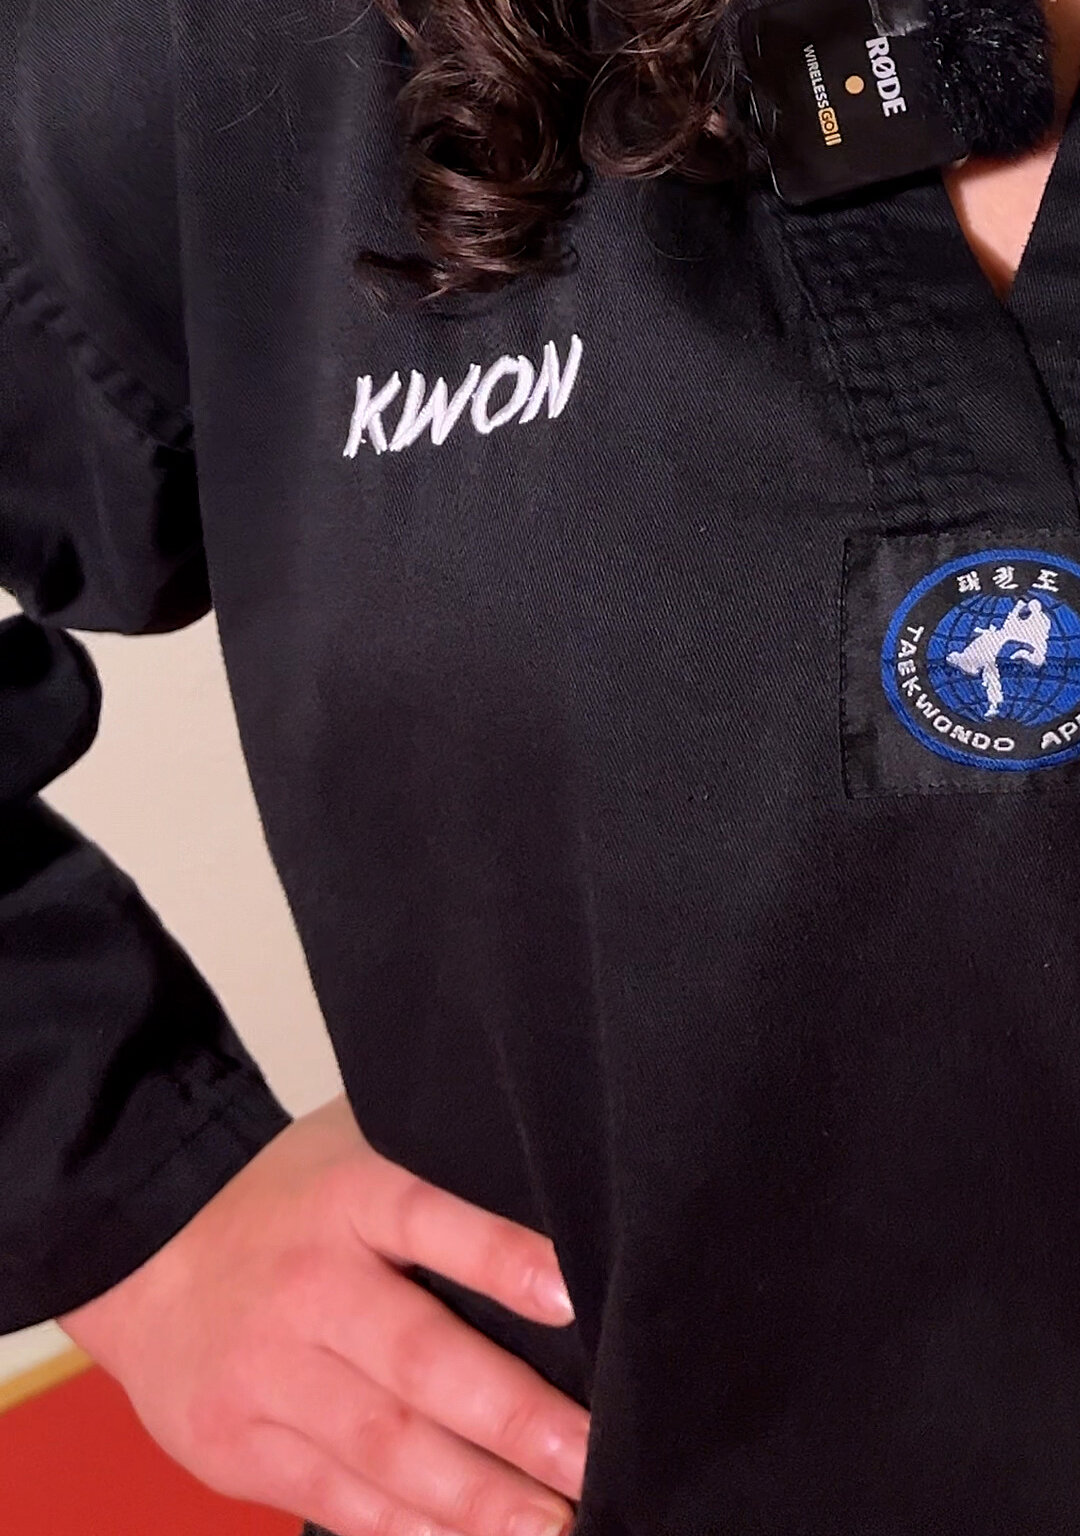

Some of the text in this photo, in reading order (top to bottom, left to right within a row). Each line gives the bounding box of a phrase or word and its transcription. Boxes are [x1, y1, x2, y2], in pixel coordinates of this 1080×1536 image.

[803, 44, 829, 108] WIRELESS
[865, 36, 907, 117] RØDE
[343, 333, 583, 459] KWON
[897, 624, 1016, 752] TAEKWONDO
